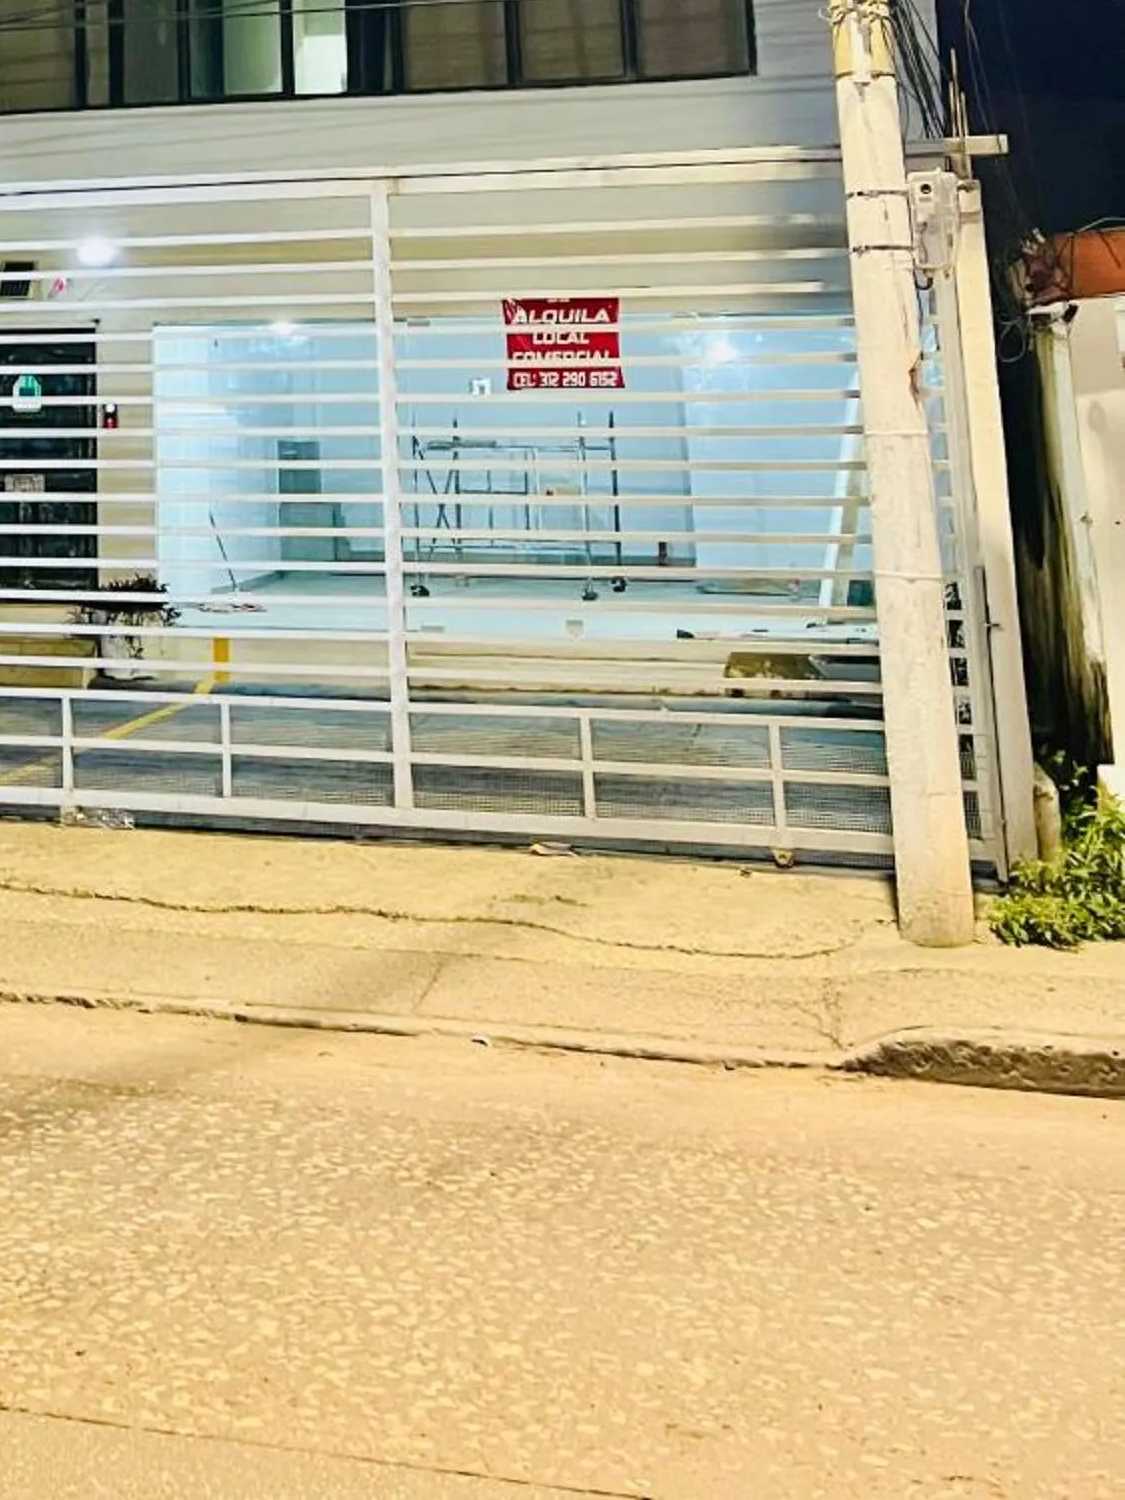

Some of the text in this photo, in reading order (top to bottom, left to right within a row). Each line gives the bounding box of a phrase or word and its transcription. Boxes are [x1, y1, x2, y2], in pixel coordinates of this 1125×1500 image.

[512, 306, 610, 324] ALQUILA
[532, 331, 590, 345] LOCAL
[562, 371, 586, 387] 290
